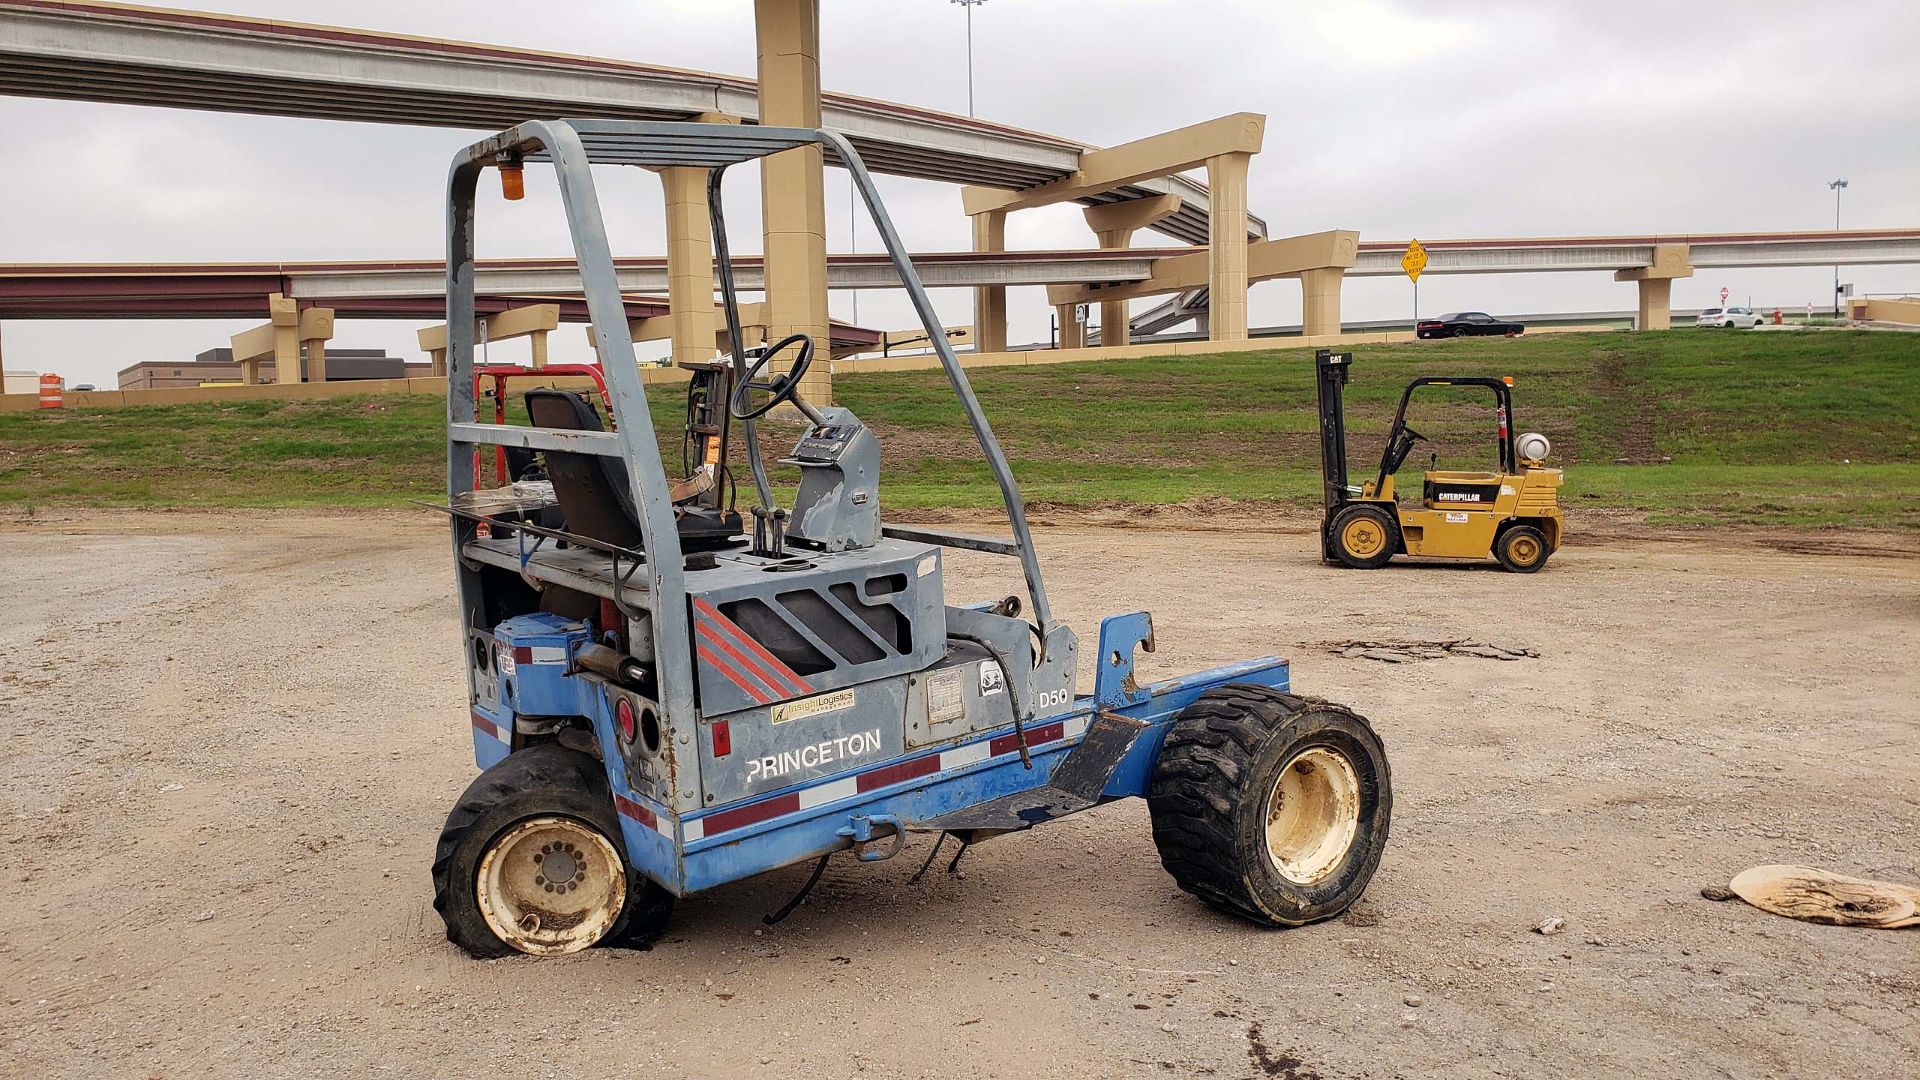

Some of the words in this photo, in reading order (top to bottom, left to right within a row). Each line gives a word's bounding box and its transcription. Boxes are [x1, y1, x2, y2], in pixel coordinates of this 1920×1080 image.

[1330, 355, 1342, 364] CAT
[1438, 492, 1481, 502] CATERPILLAR
[1040, 688, 1068, 709] D50
[745, 728, 881, 783] PRINCETON
